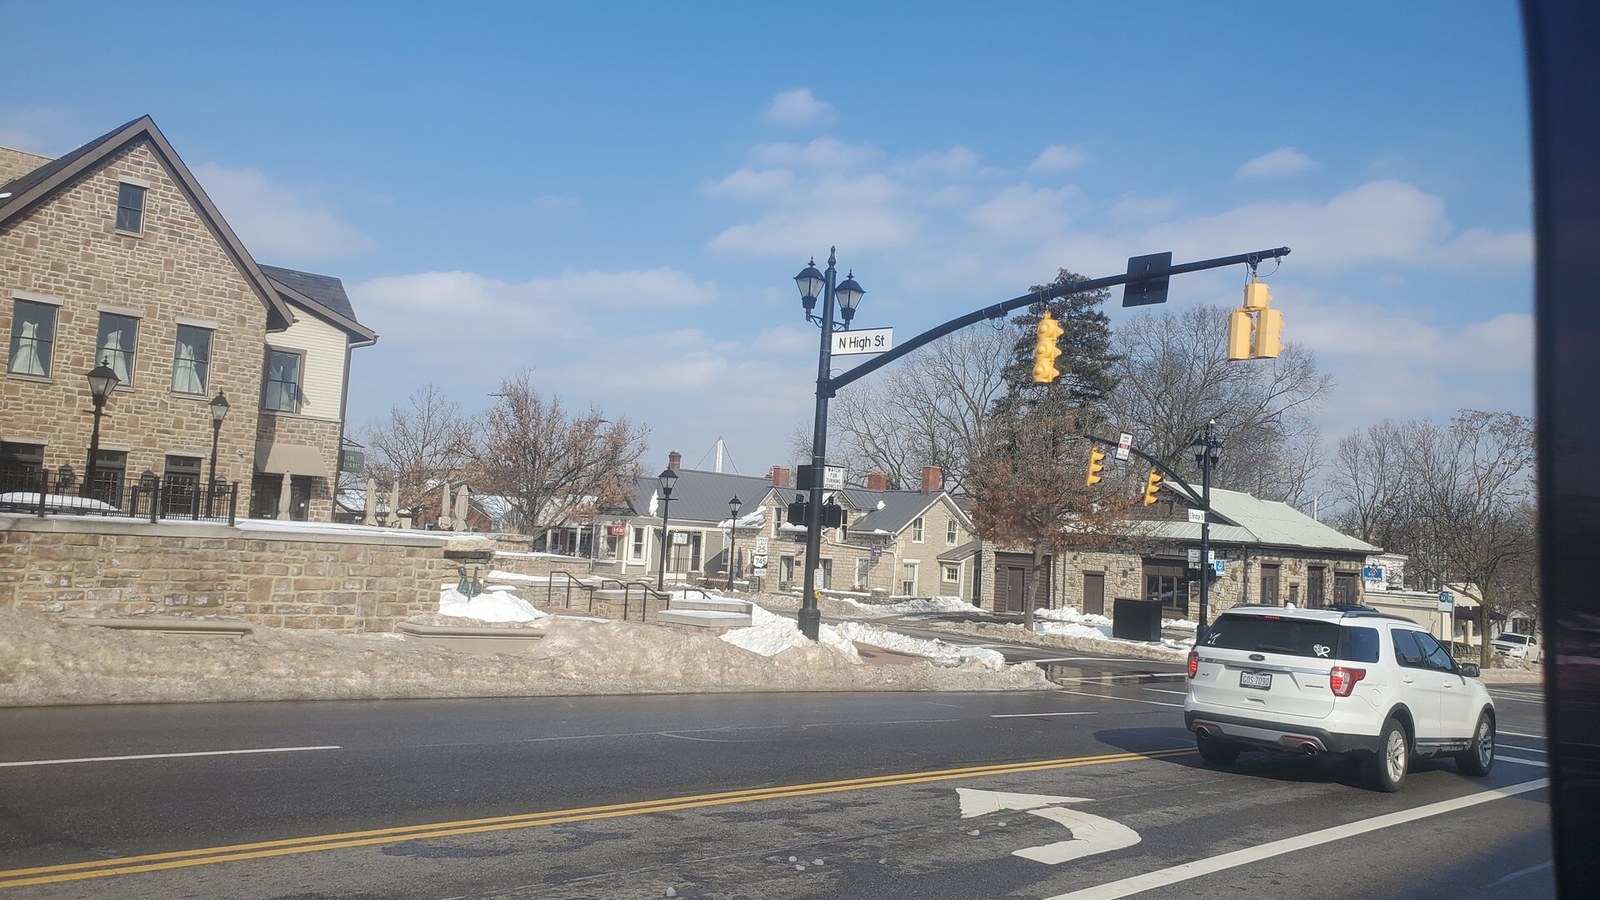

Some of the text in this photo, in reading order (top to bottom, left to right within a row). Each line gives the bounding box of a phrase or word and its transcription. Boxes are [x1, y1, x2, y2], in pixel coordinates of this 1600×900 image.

[839, 335, 885, 351] N High St
[755, 557, 767, 565] 745
